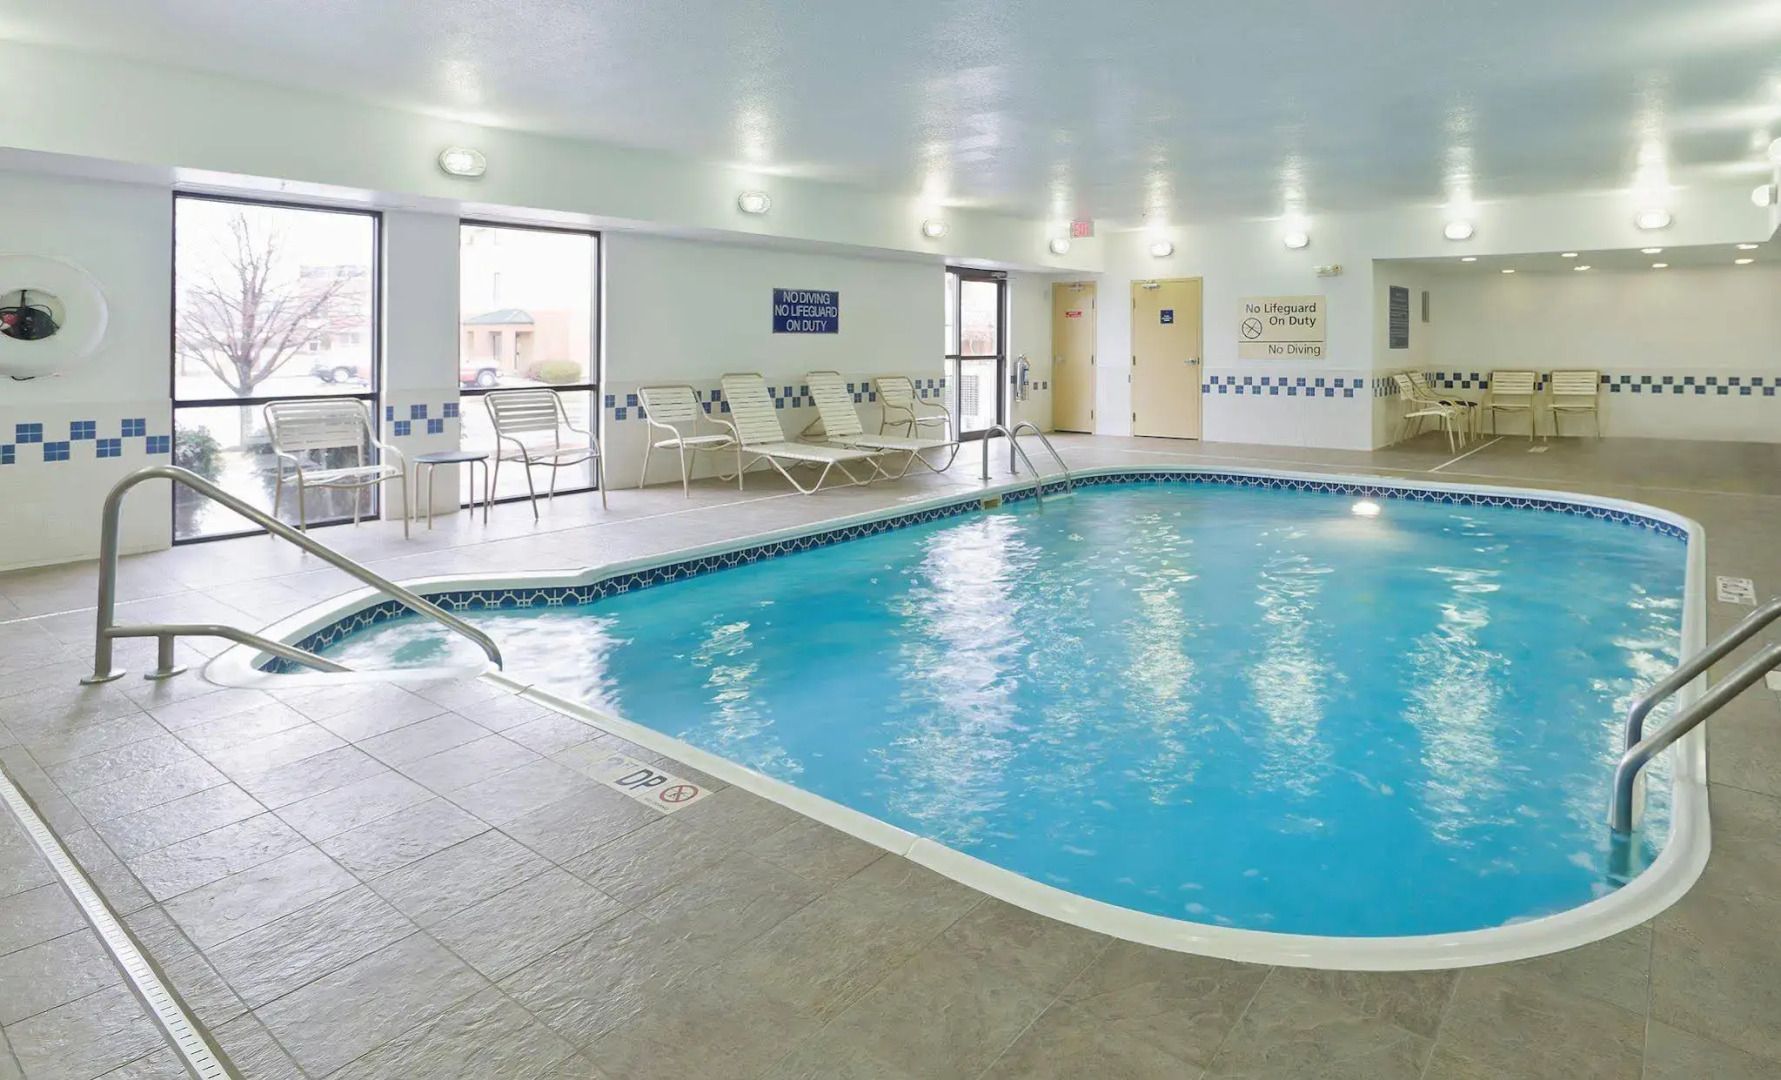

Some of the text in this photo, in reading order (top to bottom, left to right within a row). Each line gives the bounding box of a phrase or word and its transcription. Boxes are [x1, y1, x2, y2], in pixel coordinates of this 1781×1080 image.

[783, 291, 831, 304] NO DIVING
[774, 304, 838, 317] NO LIFEGUARD
[1245, 302, 1317, 315] No Lifeguard
[786, 319, 827, 331] ON DUTY
[1269, 316, 1317, 328] On Duty
[1268, 344, 1321, 357] No Diving
[615, 768, 668, 790] DP
